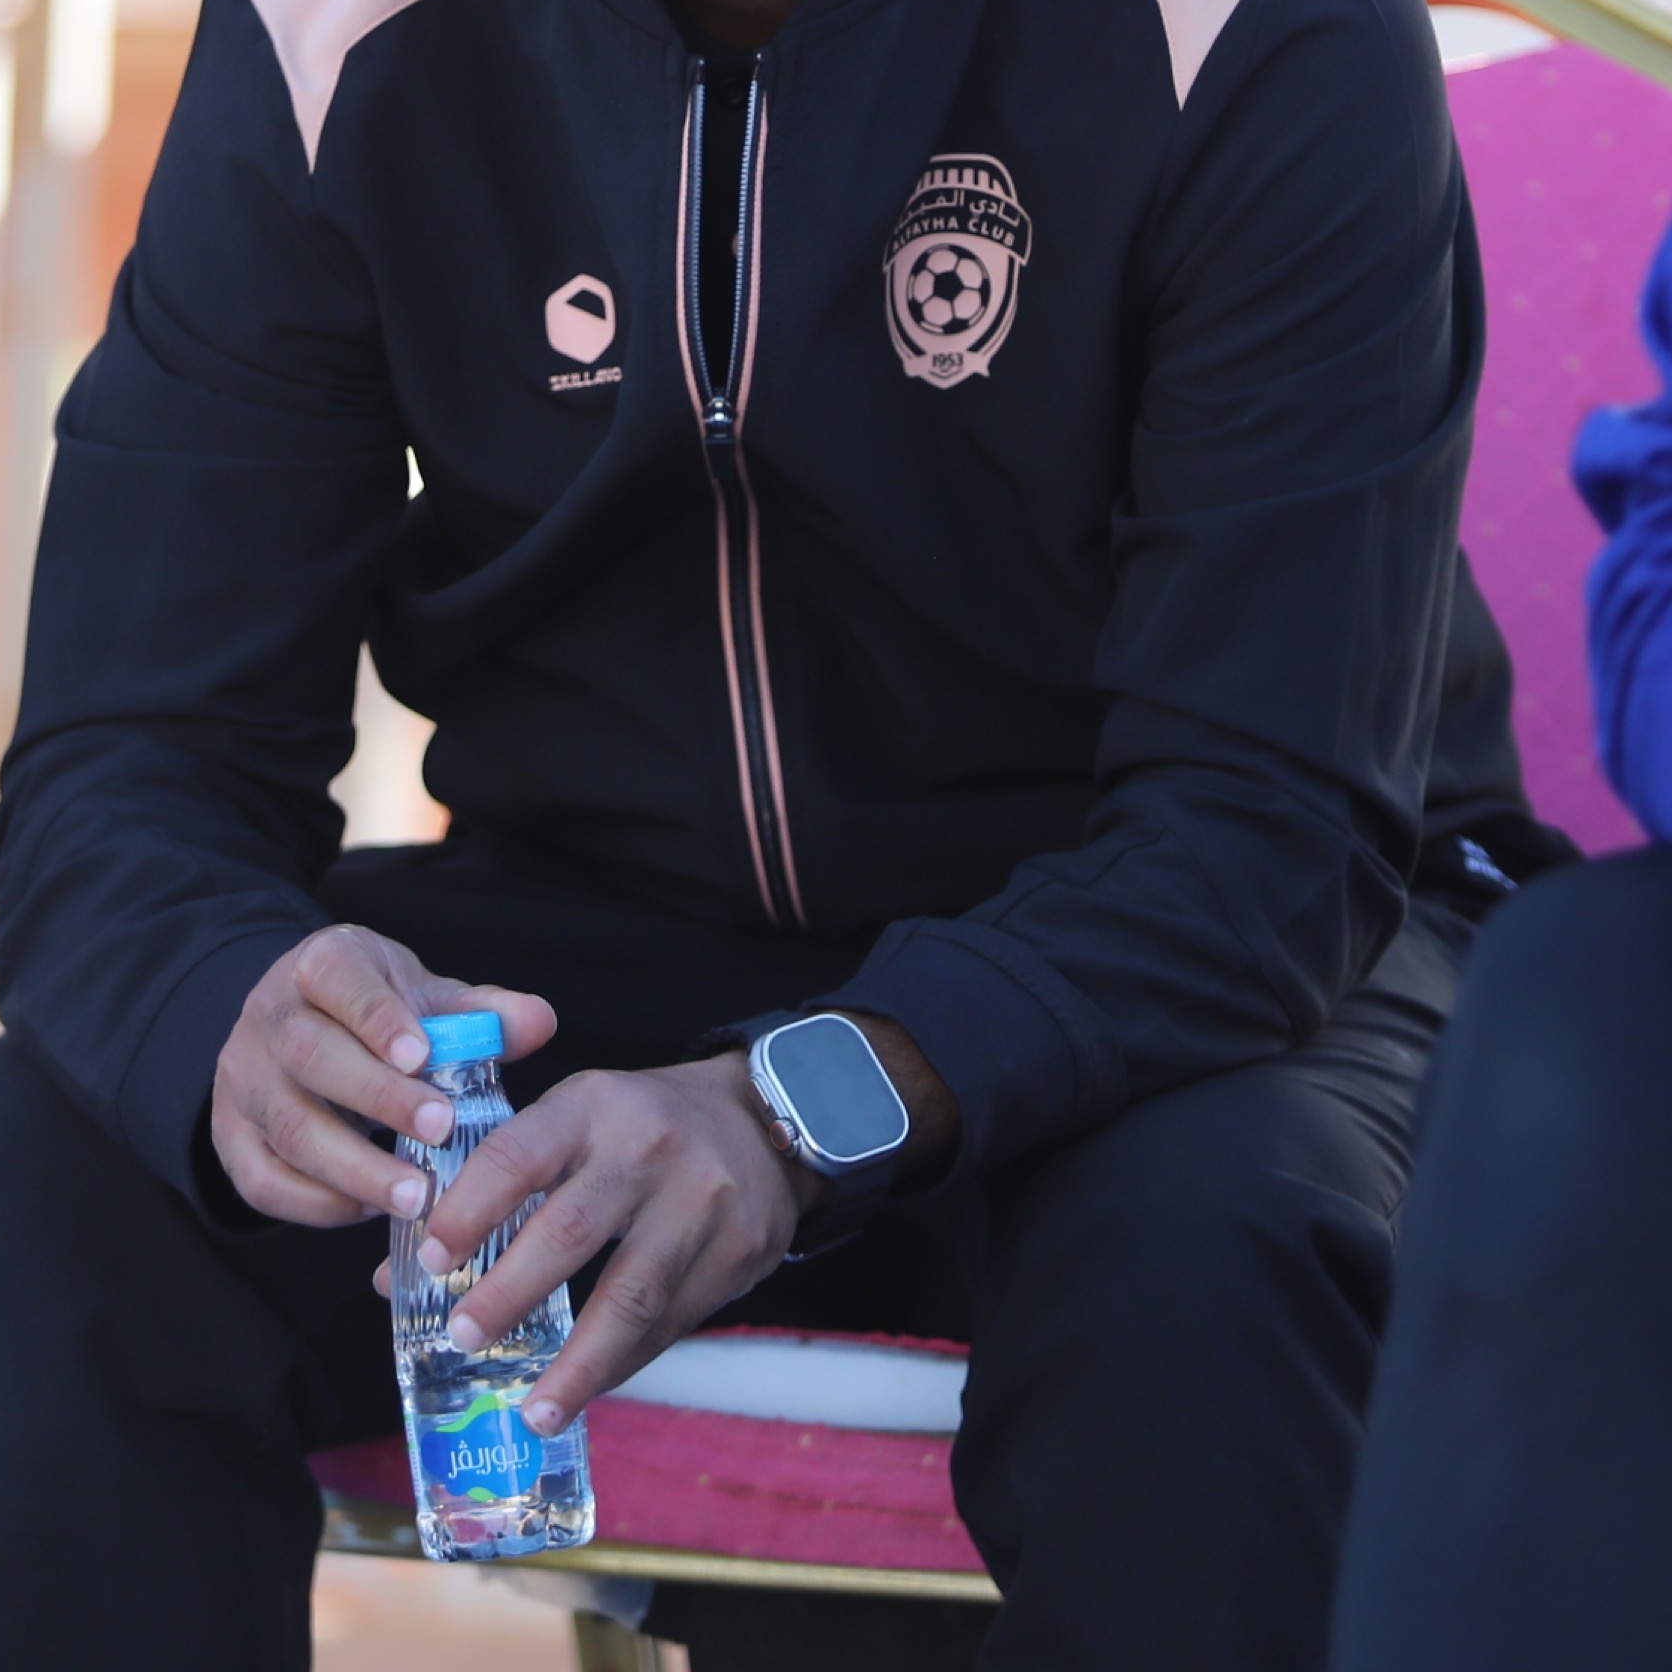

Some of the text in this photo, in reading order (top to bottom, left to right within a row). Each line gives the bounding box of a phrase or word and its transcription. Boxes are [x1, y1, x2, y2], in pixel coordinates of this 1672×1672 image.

[969, 199, 1021, 227] نادي
[892, 215, 1015, 251] ALFAYHA CLUB
[932, 352, 964, 367] 1953
